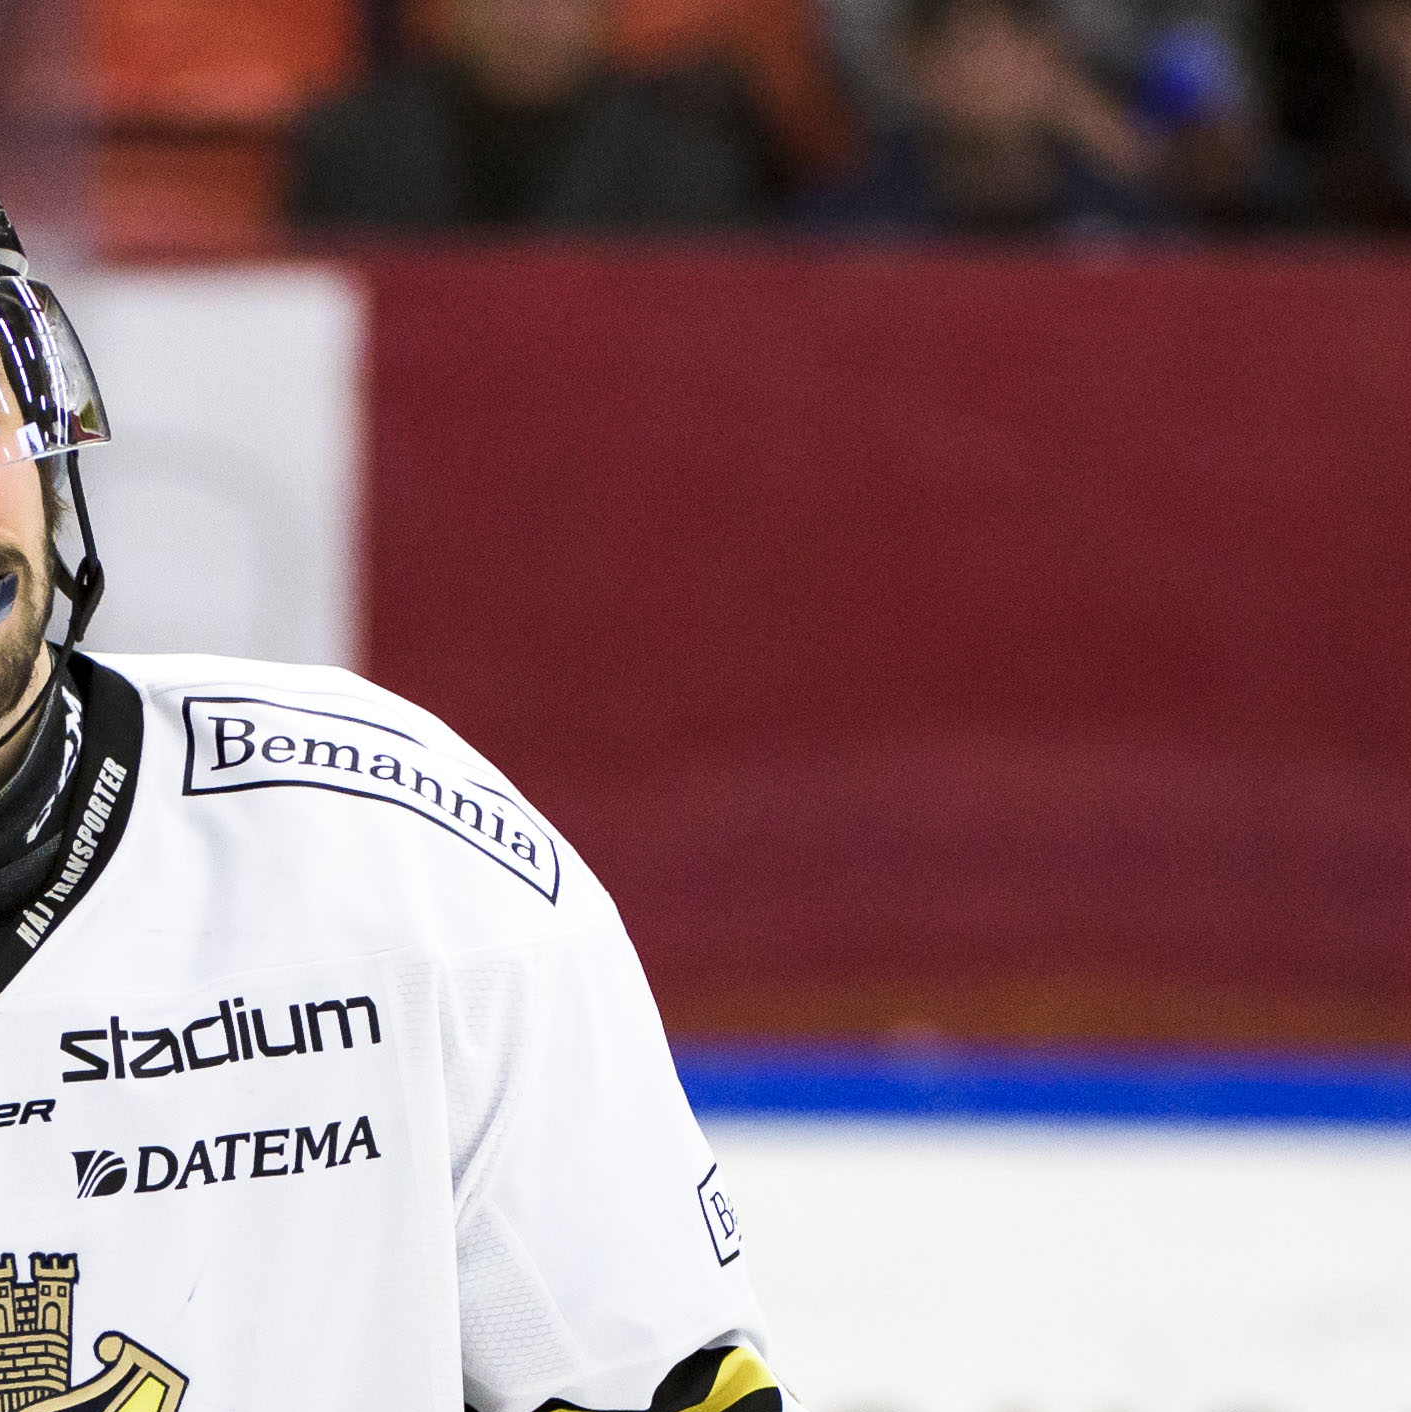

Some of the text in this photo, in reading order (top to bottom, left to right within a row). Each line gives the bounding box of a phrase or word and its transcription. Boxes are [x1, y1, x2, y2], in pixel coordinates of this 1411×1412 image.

[44, 756, 128, 903] TRANSPORTER
[208, 715, 541, 871] Bemannia
[59, 995, 383, 1084] stadium
[134, 1115, 382, 1197] DATEMA
